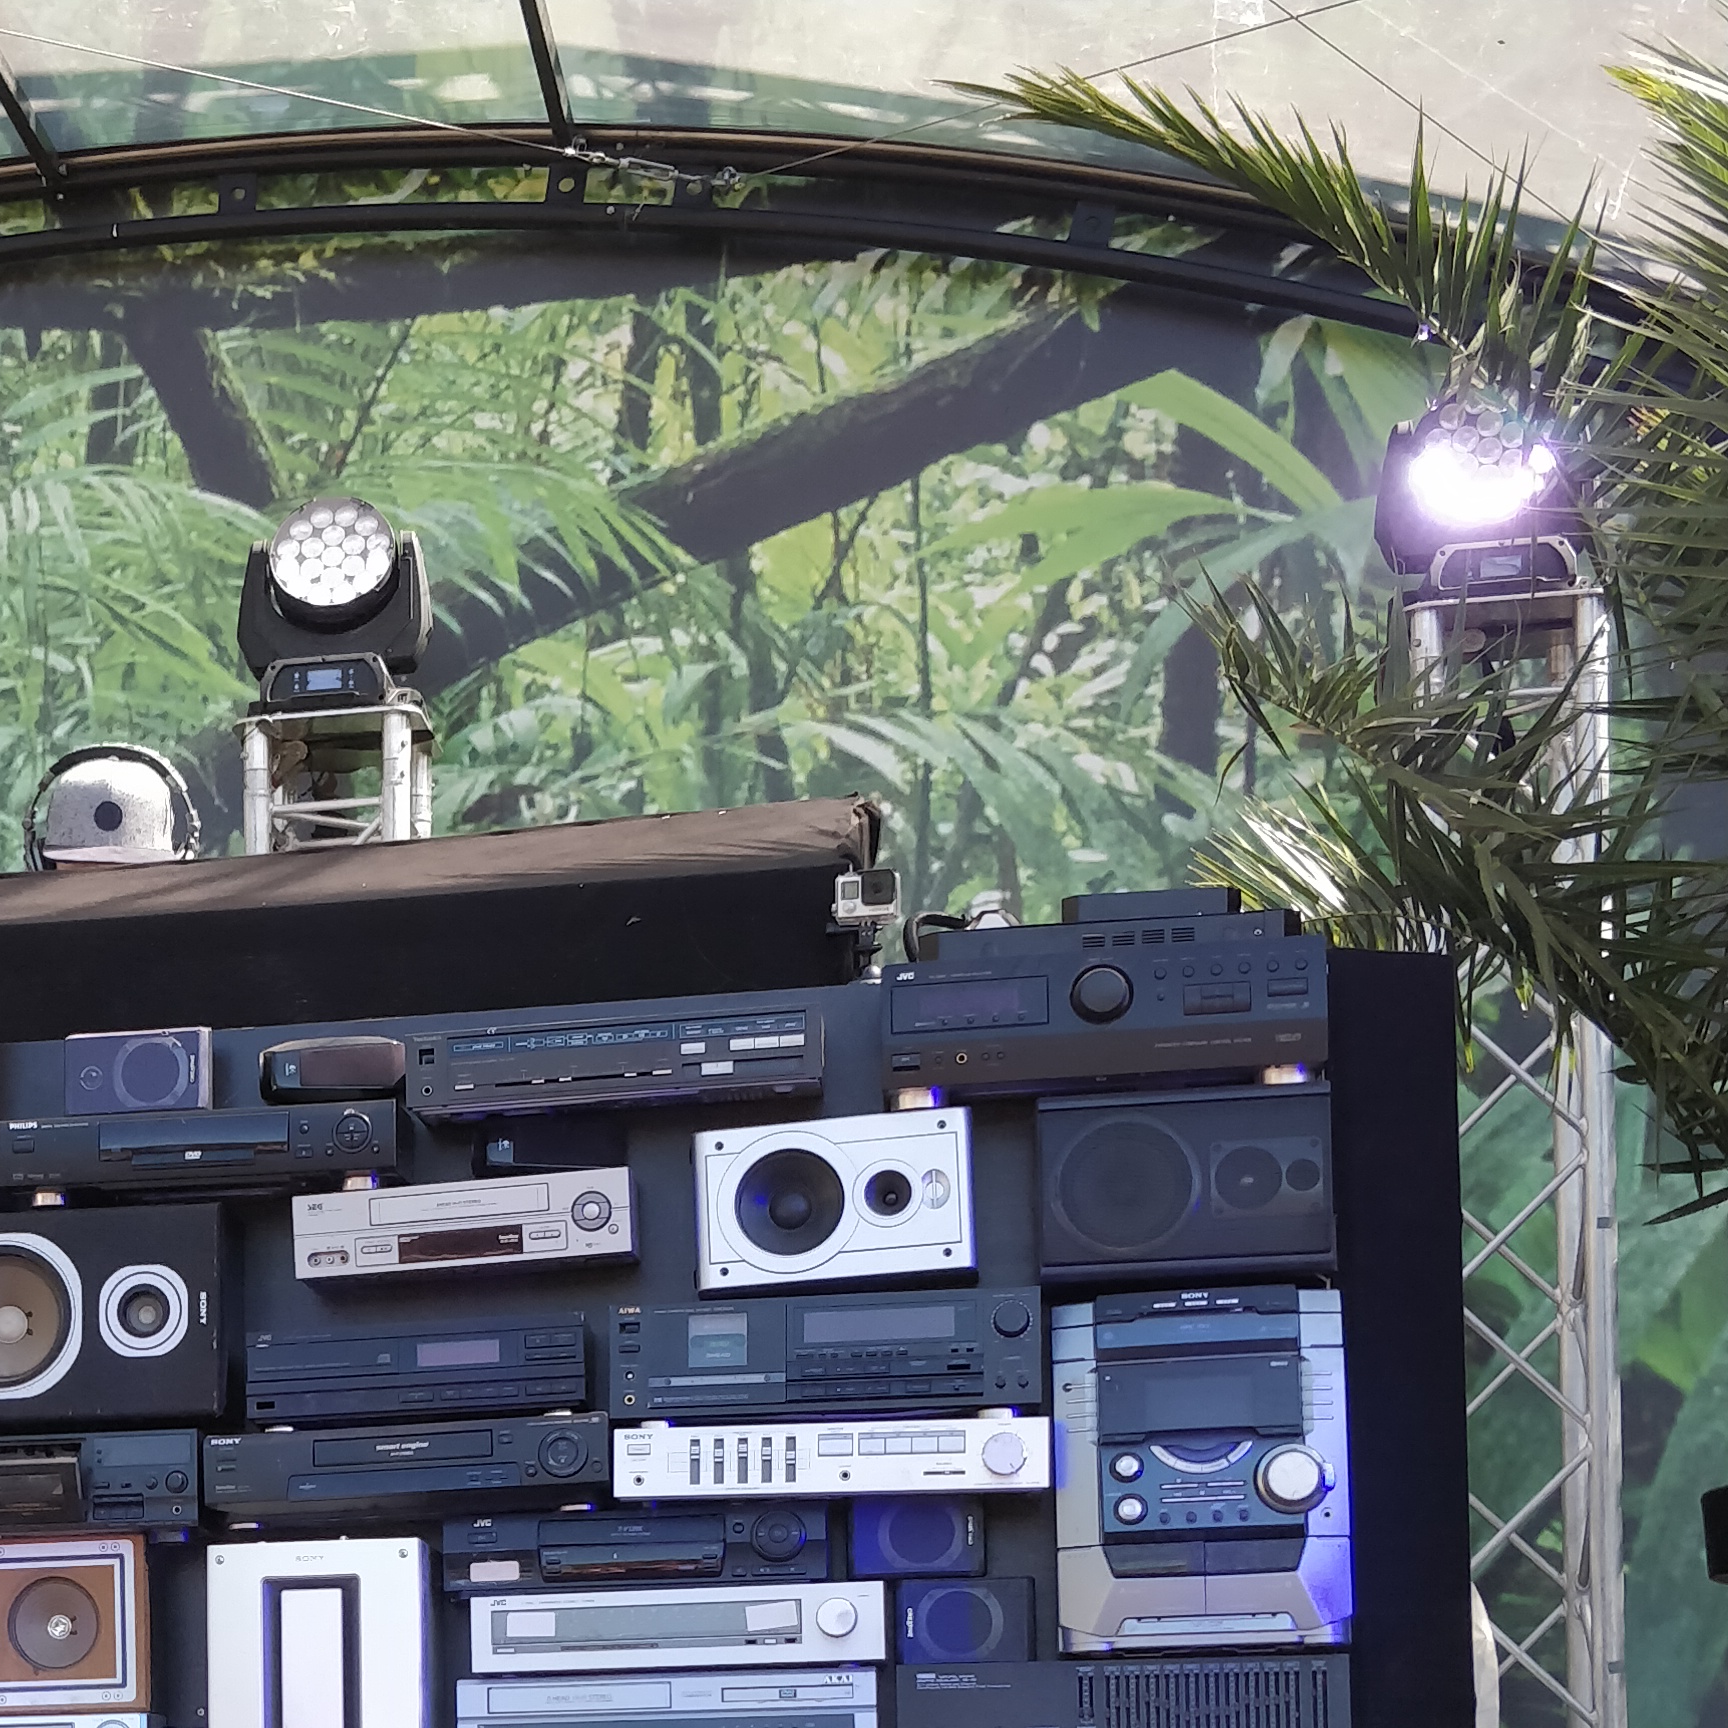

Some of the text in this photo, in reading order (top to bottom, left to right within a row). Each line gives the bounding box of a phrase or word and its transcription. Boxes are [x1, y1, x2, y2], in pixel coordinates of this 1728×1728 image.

[896, 972, 915, 981] JVC
[9, 1121, 38, 1130] PHILIPS
[199, 1291, 207, 1325] SONY
[618, 1306, 641, 1314] AIWA
[257, 1334, 272, 1342] JVC
[210, 1437, 242, 1446] SONY
[375, 1441, 429, 1451] smart engine
[473, 1519, 492, 1527] JVC
[295, 1555, 324, 1563] SONY
[824, 1674, 853, 1684] AKAI
